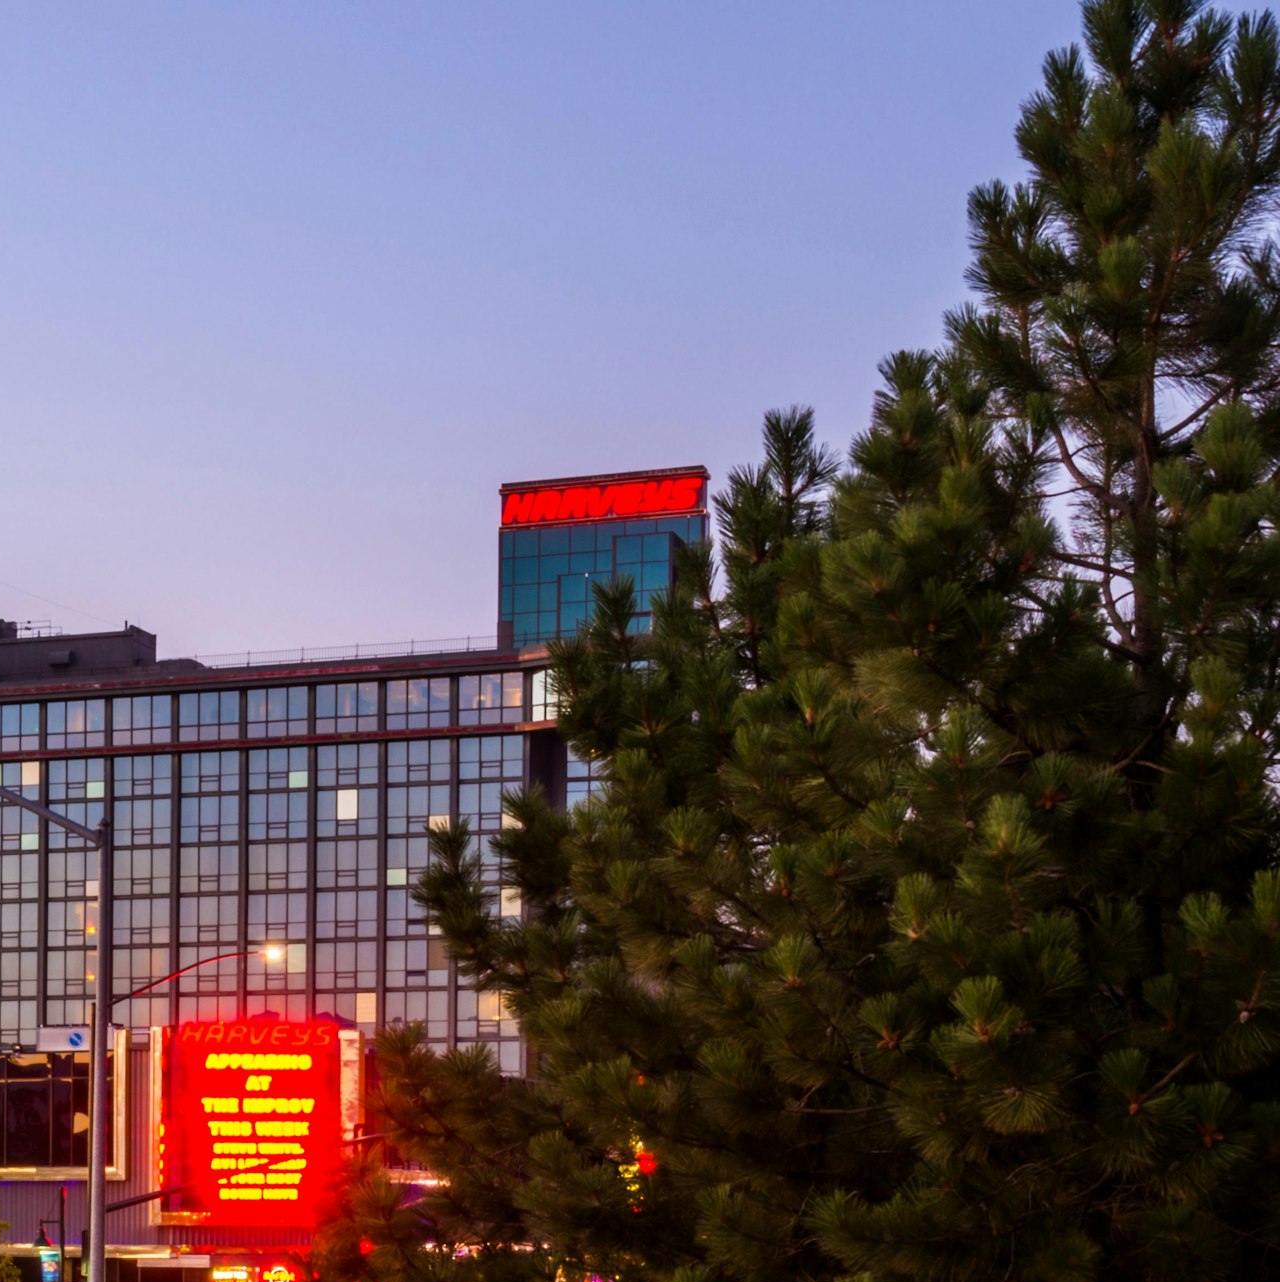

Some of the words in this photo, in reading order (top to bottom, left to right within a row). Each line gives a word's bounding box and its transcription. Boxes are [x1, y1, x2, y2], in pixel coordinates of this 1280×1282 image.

[502, 477, 704, 524] HARVEYS
[181, 1024, 332, 1047] HARVEYS
[205, 1053, 312, 1070] APPEARING
[245, 1075, 272, 1091] AT
[201, 1097, 239, 1113] THE
[242, 1098, 315, 1114] IMPROV
[207, 1121, 253, 1137] THIS
[254, 1121, 310, 1137] WEEK
